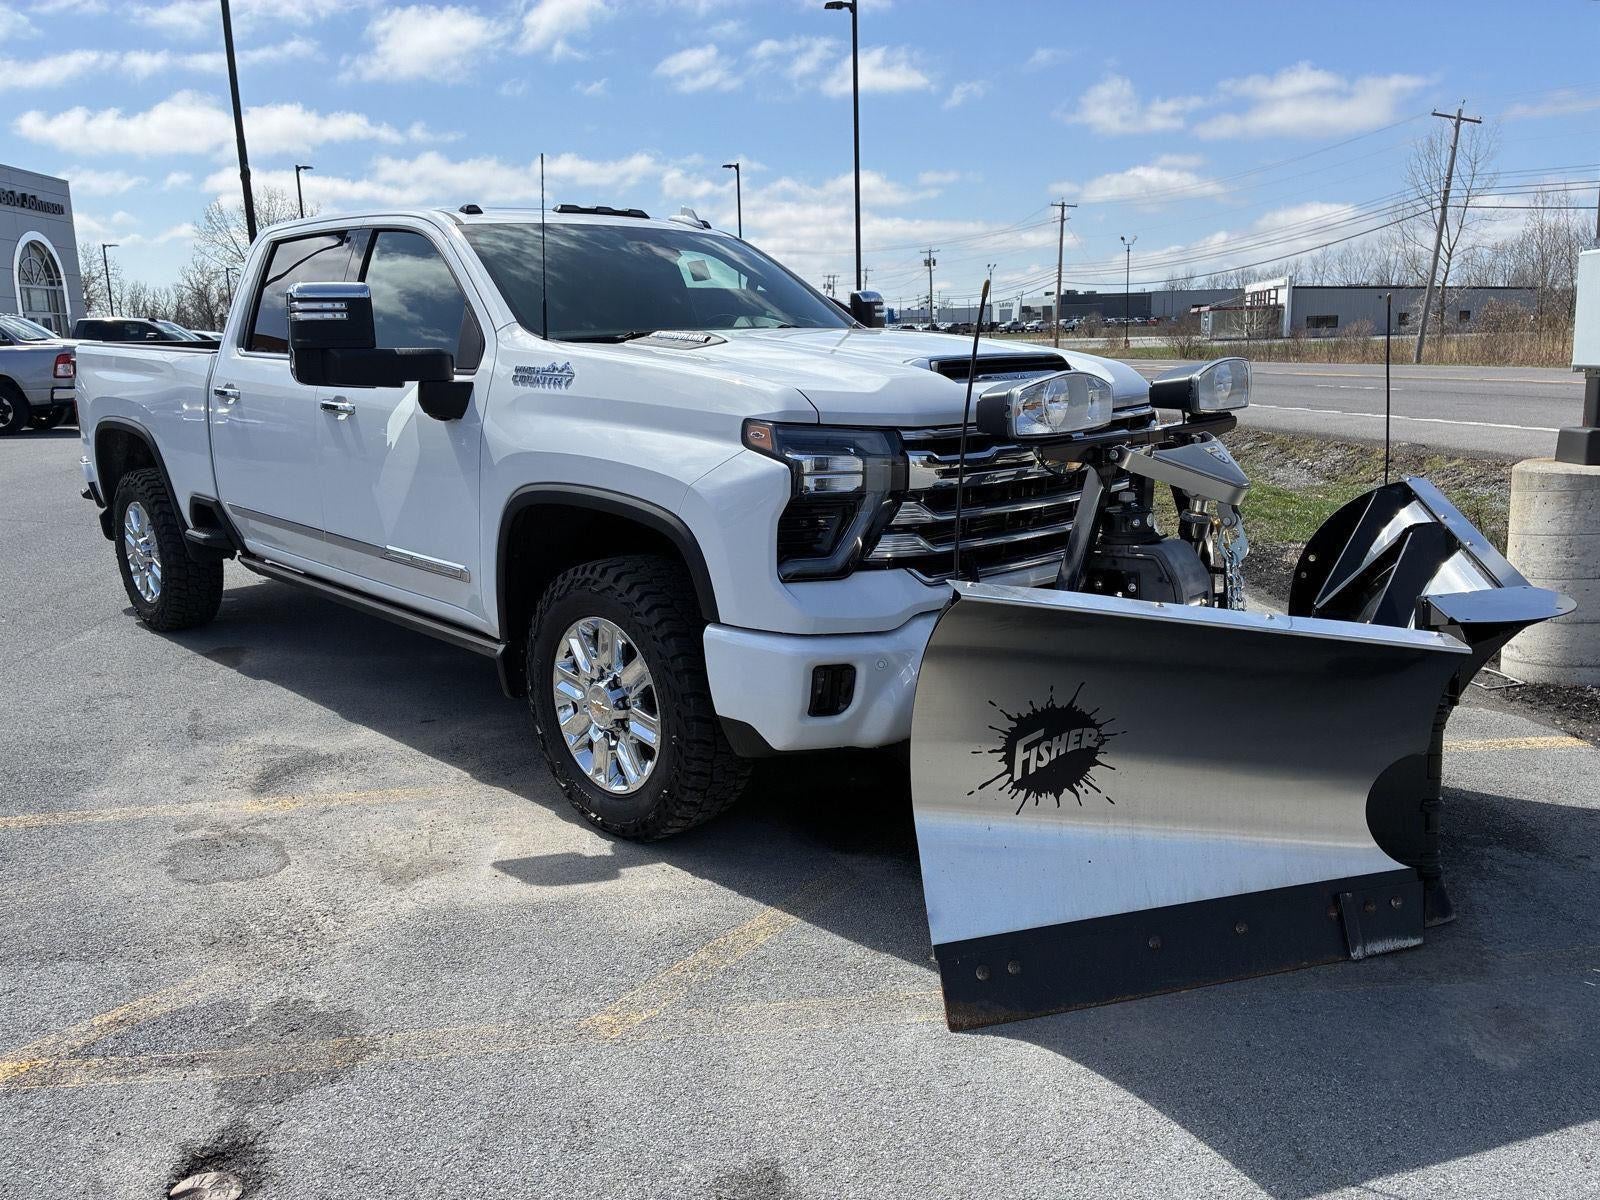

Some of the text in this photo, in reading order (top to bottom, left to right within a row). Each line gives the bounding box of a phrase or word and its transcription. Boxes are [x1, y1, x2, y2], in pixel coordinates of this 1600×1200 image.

[0, 188, 65, 215] Bob Johnson
[512, 374, 575, 390] COUNTRY
